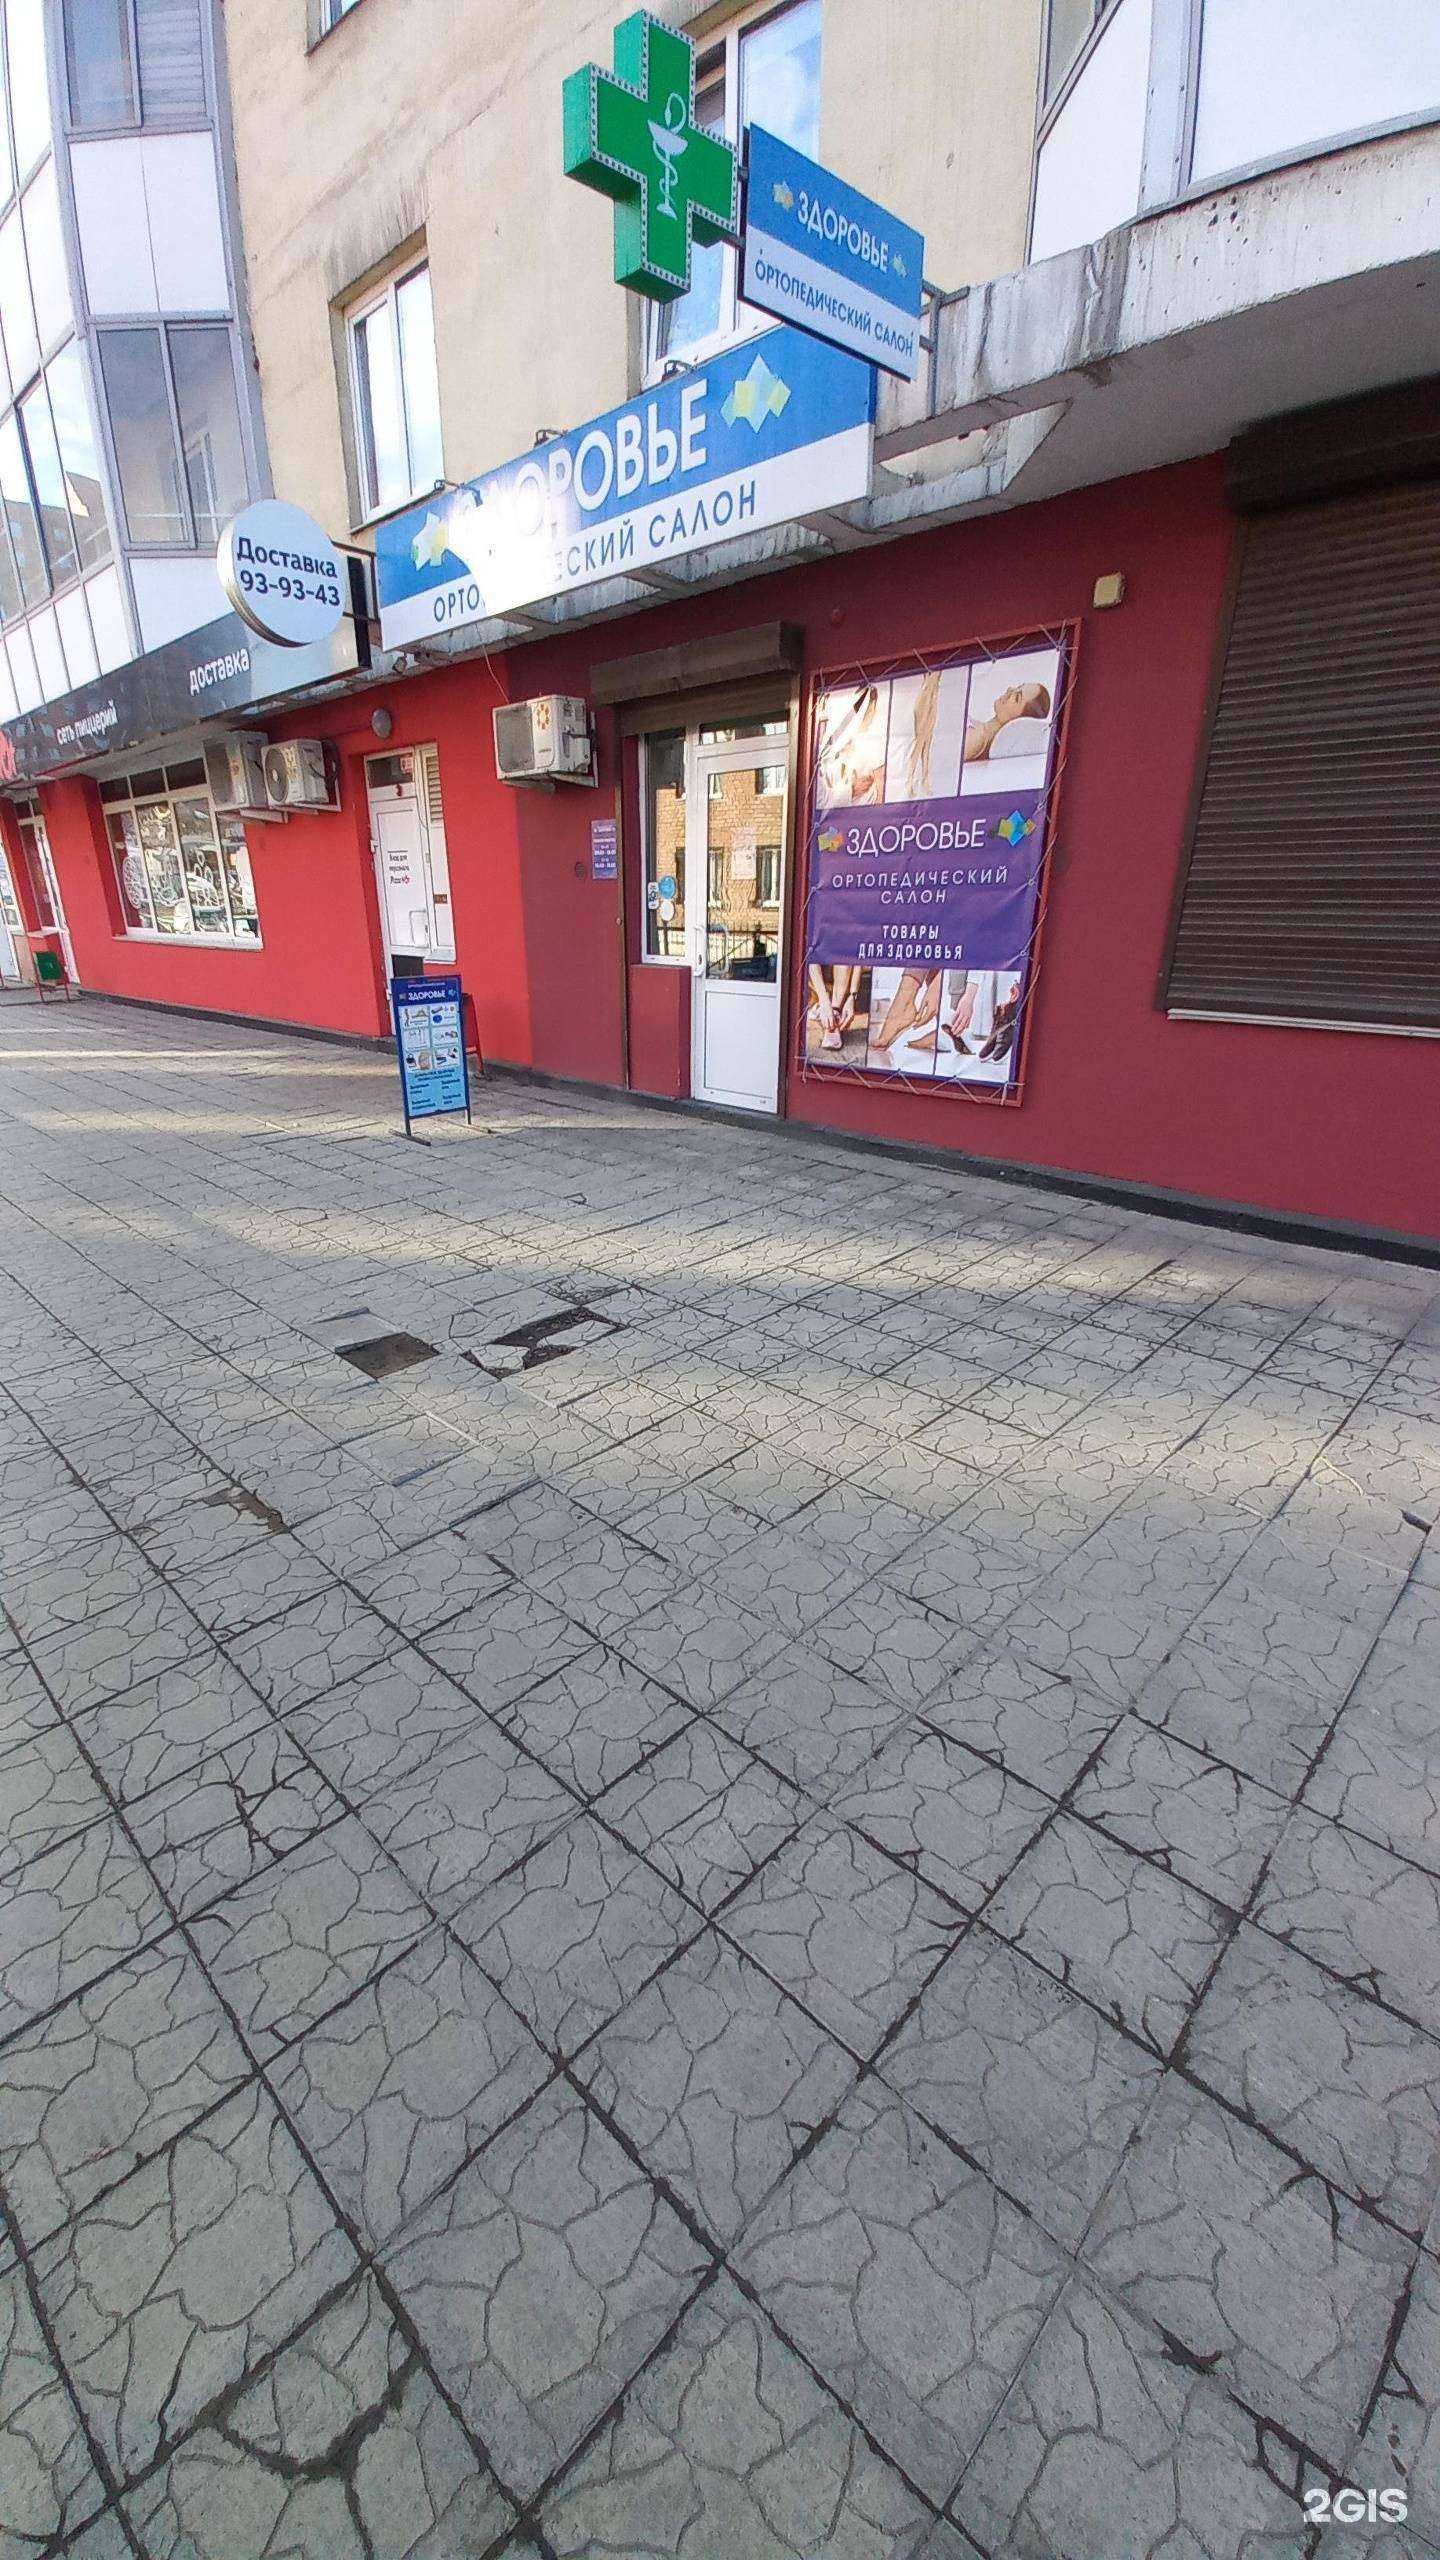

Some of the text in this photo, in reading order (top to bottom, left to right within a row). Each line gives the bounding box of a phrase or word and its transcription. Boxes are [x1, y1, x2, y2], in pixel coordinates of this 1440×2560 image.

[797, 190, 889, 273] ЗДОРОВЬЕ
[754, 259, 913, 356] ОРТОПЕДИЧЕСКИЙ САЛОН
[455, 378, 709, 550] ОРОВЬЕ
[648, 480, 756, 549] САЛОН
[236, 536, 338, 579] Доставка
[239, 569, 341, 607] 93-93-43
[189, 647, 250, 696] доставка
[846, 818, 987, 858] ЗДОРОВЬЕ
[832, 865, 1009, 889] ОРТОПЕДИЧЕСКИЙ
[880, 889, 948, 905] САЛОН
[858, 943, 963, 961] ДЛЯ ЗДОРОВЬЯ
[882, 924, 940, 940] ТОВАРЫ
